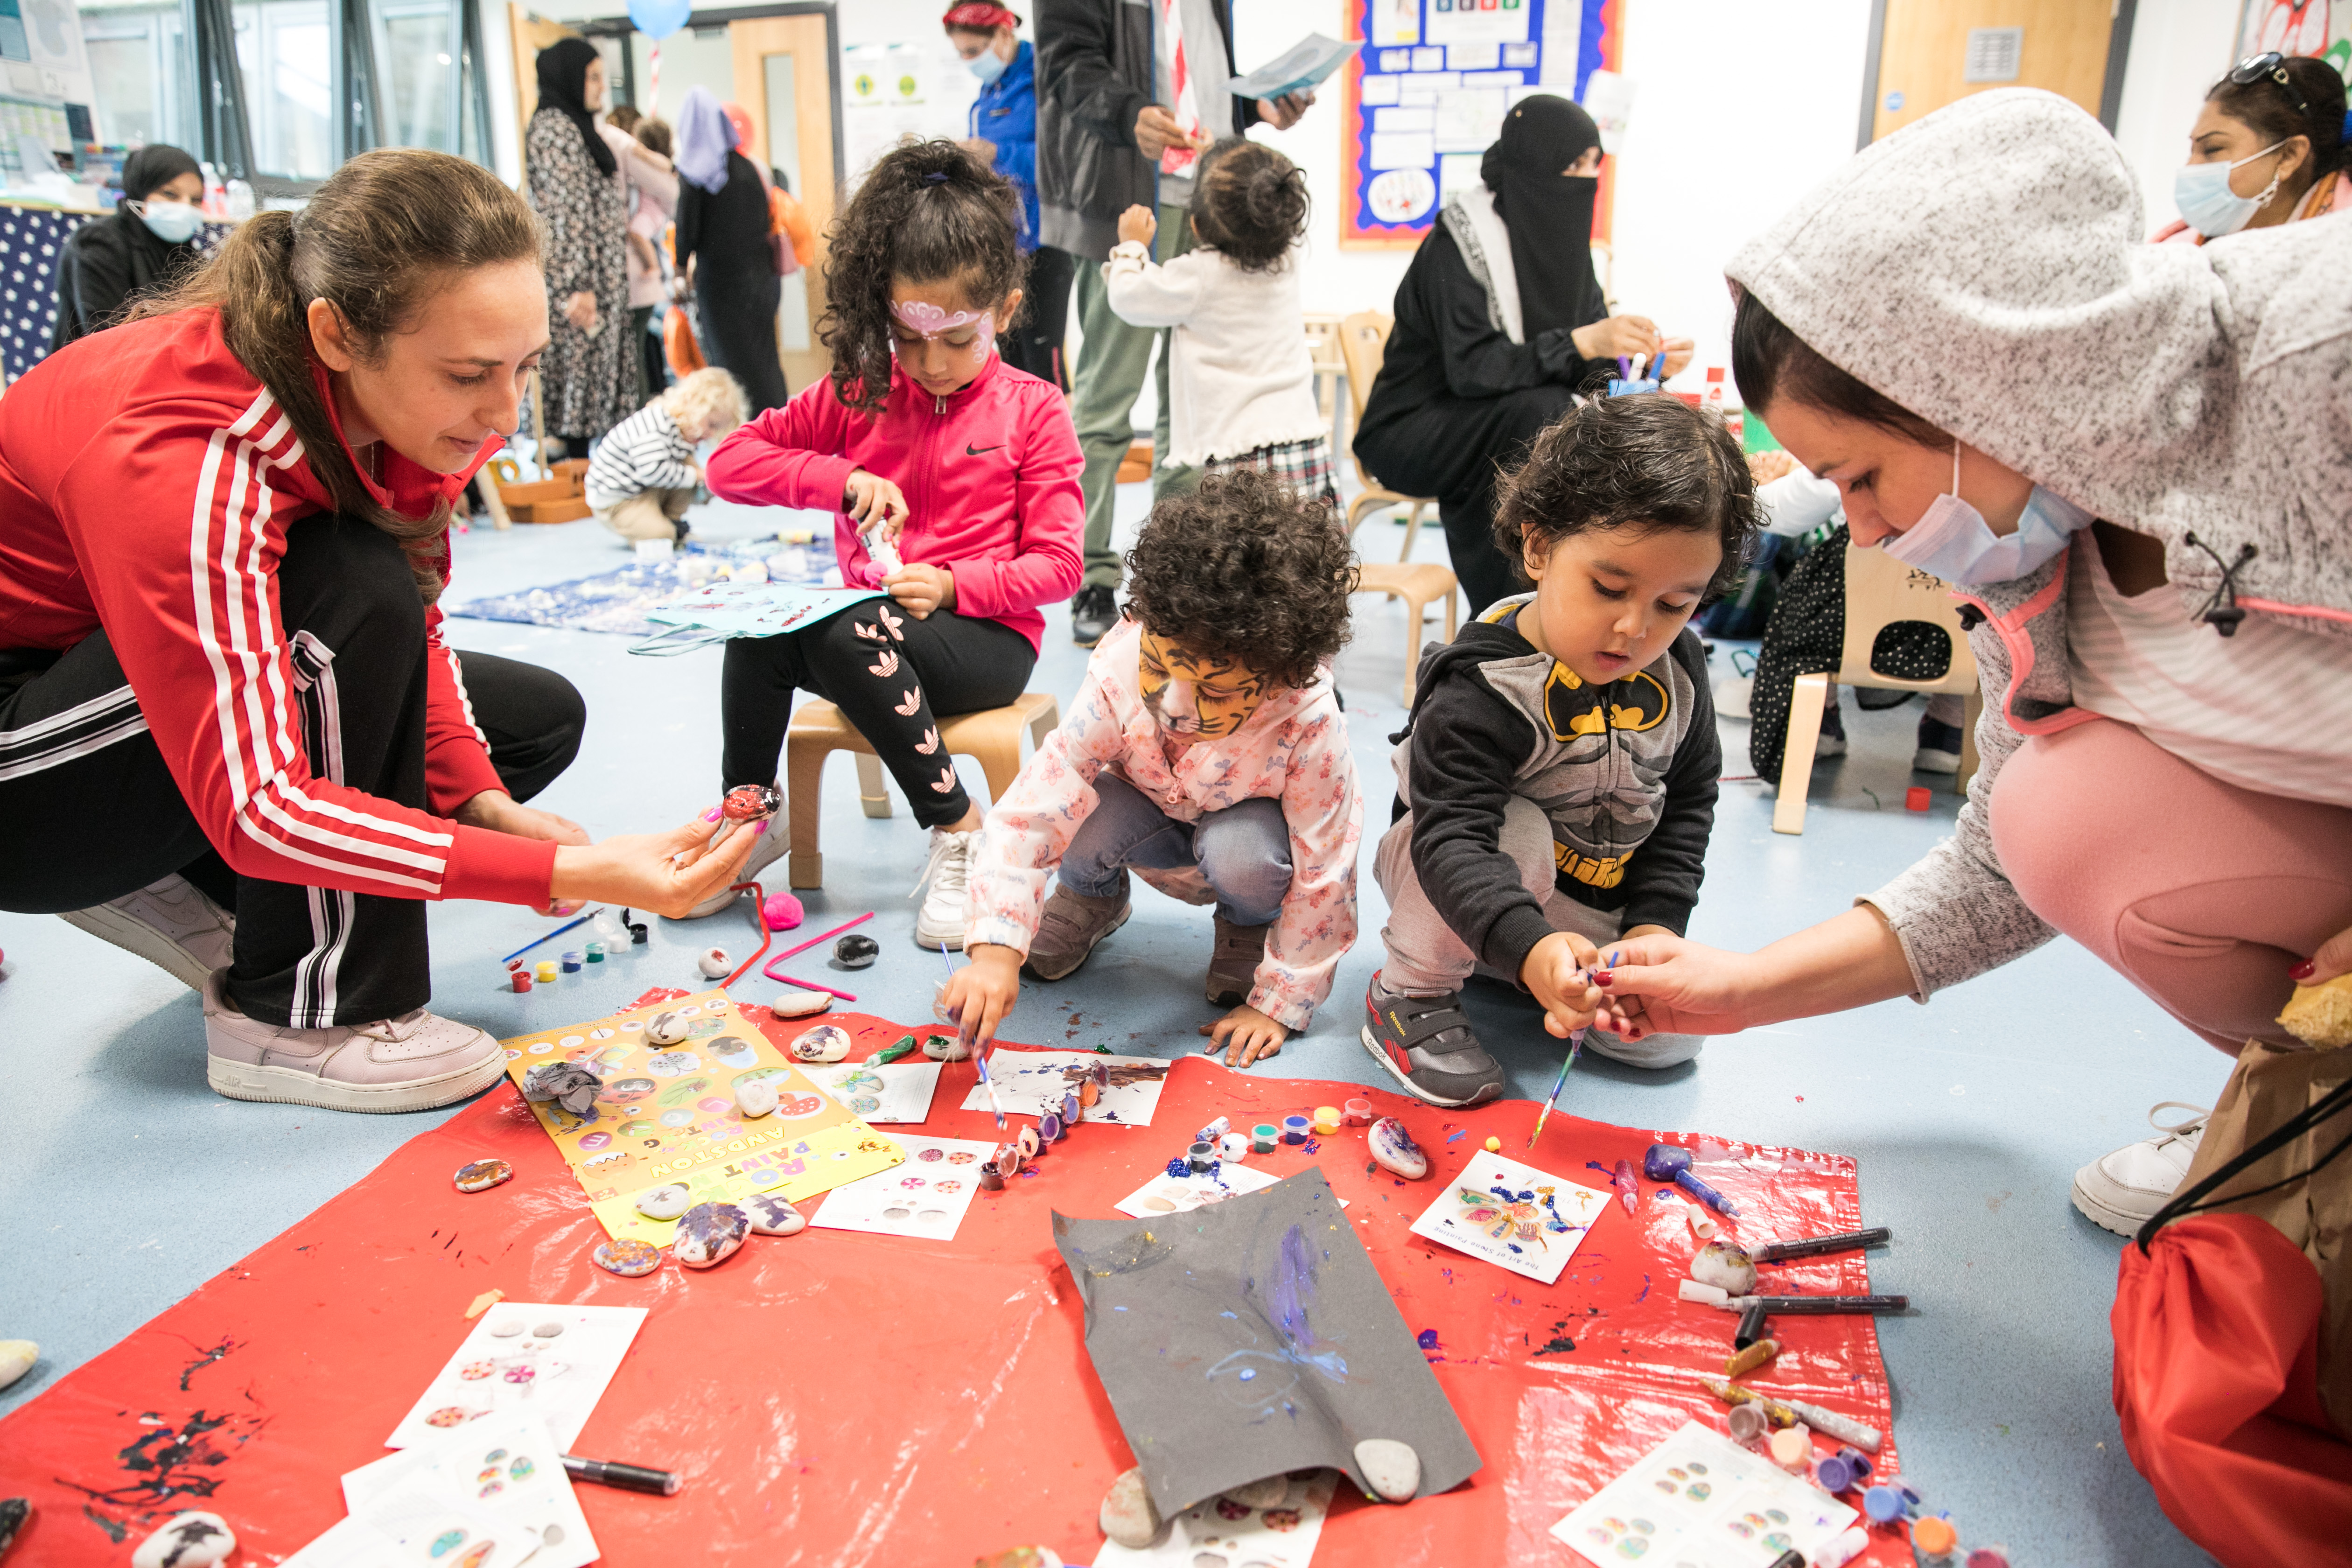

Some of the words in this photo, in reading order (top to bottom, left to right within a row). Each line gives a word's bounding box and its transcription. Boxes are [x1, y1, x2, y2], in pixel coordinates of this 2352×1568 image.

[1389, 1011, 1406, 1037] Reebok
[1367, 1038, 1387, 1060] Reebok
[644, 1113, 740, 1148] AINTING
[679, 1124, 744, 1151] ROCK
[650, 1126, 784, 1178] ANDSTON
[669, 1141, 812, 1191] PAINTN
[696, 1157, 807, 1203] ROCK
[1434, 1226, 1467, 1244] Painting
[1471, 1241, 1494, 1254] Stone
[1525, 1261, 1539, 1270] The
